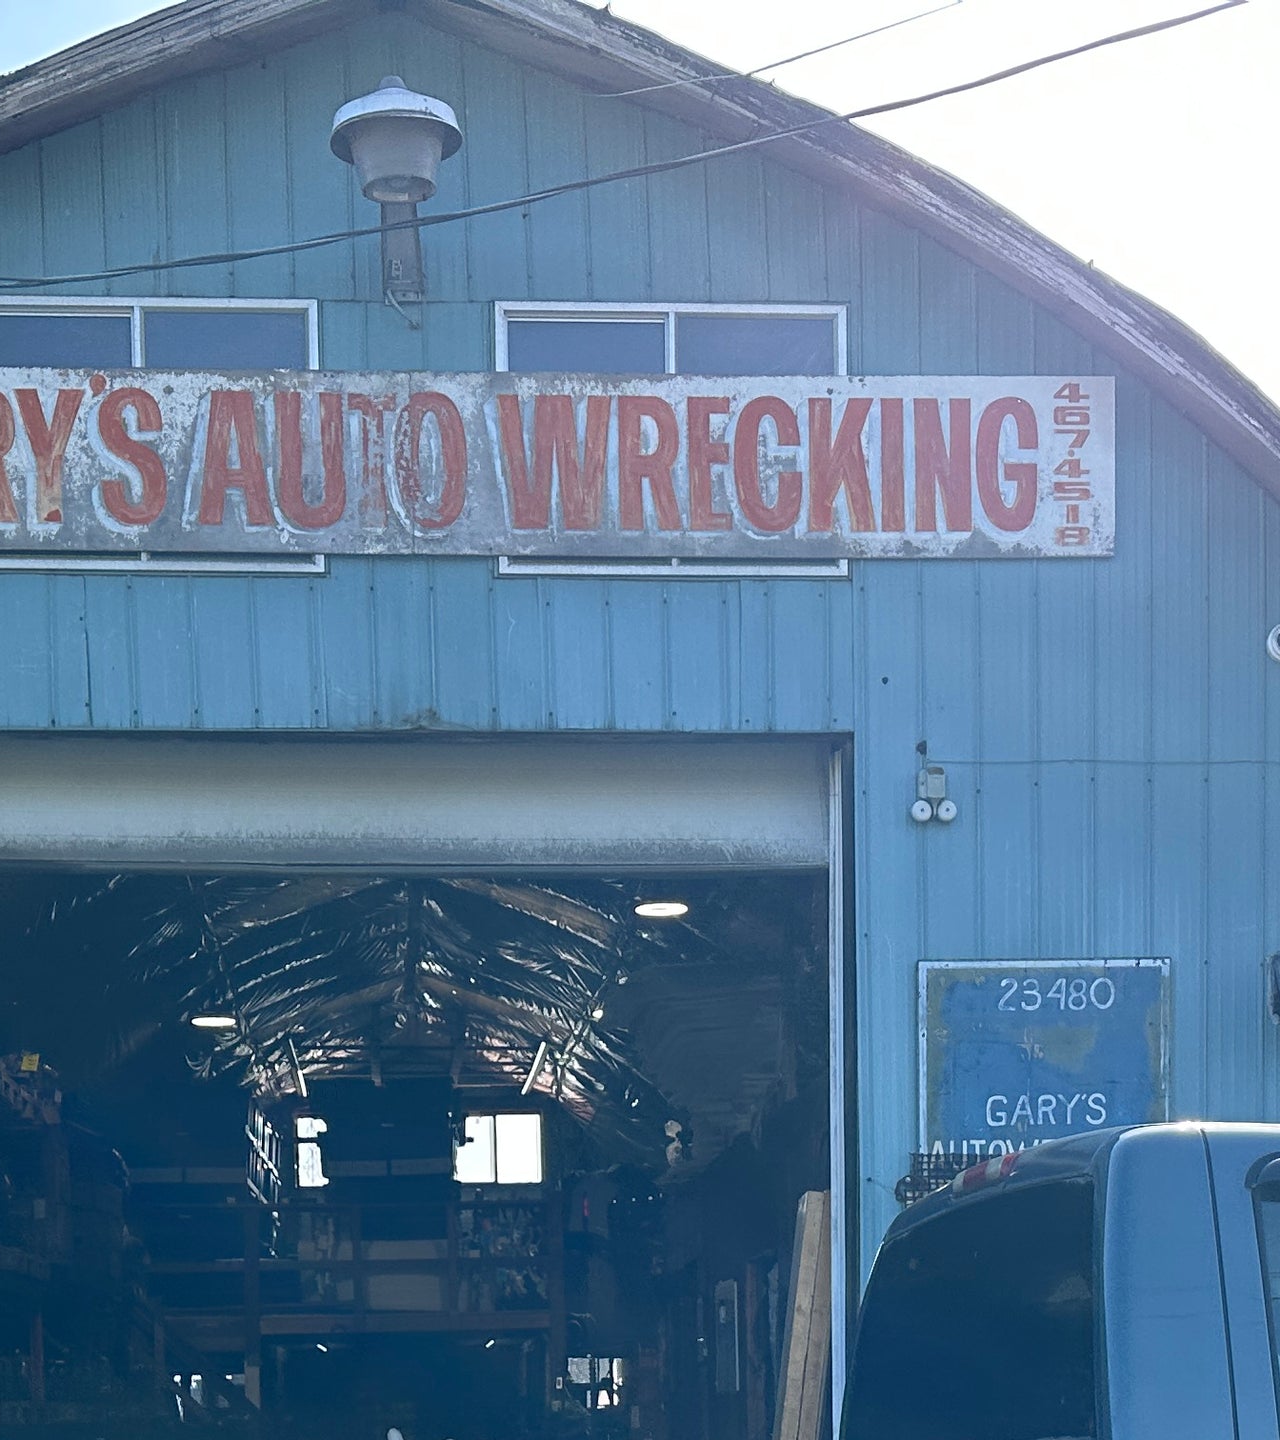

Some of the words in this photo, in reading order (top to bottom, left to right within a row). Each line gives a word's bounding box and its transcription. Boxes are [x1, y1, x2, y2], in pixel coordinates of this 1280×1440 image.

[198, 390, 467, 530] AUTO
[497, 394, 1040, 533] WRECKING
[997, 976, 1117, 1012] 23480
[985, 1092, 1107, 1127] GARY'S
